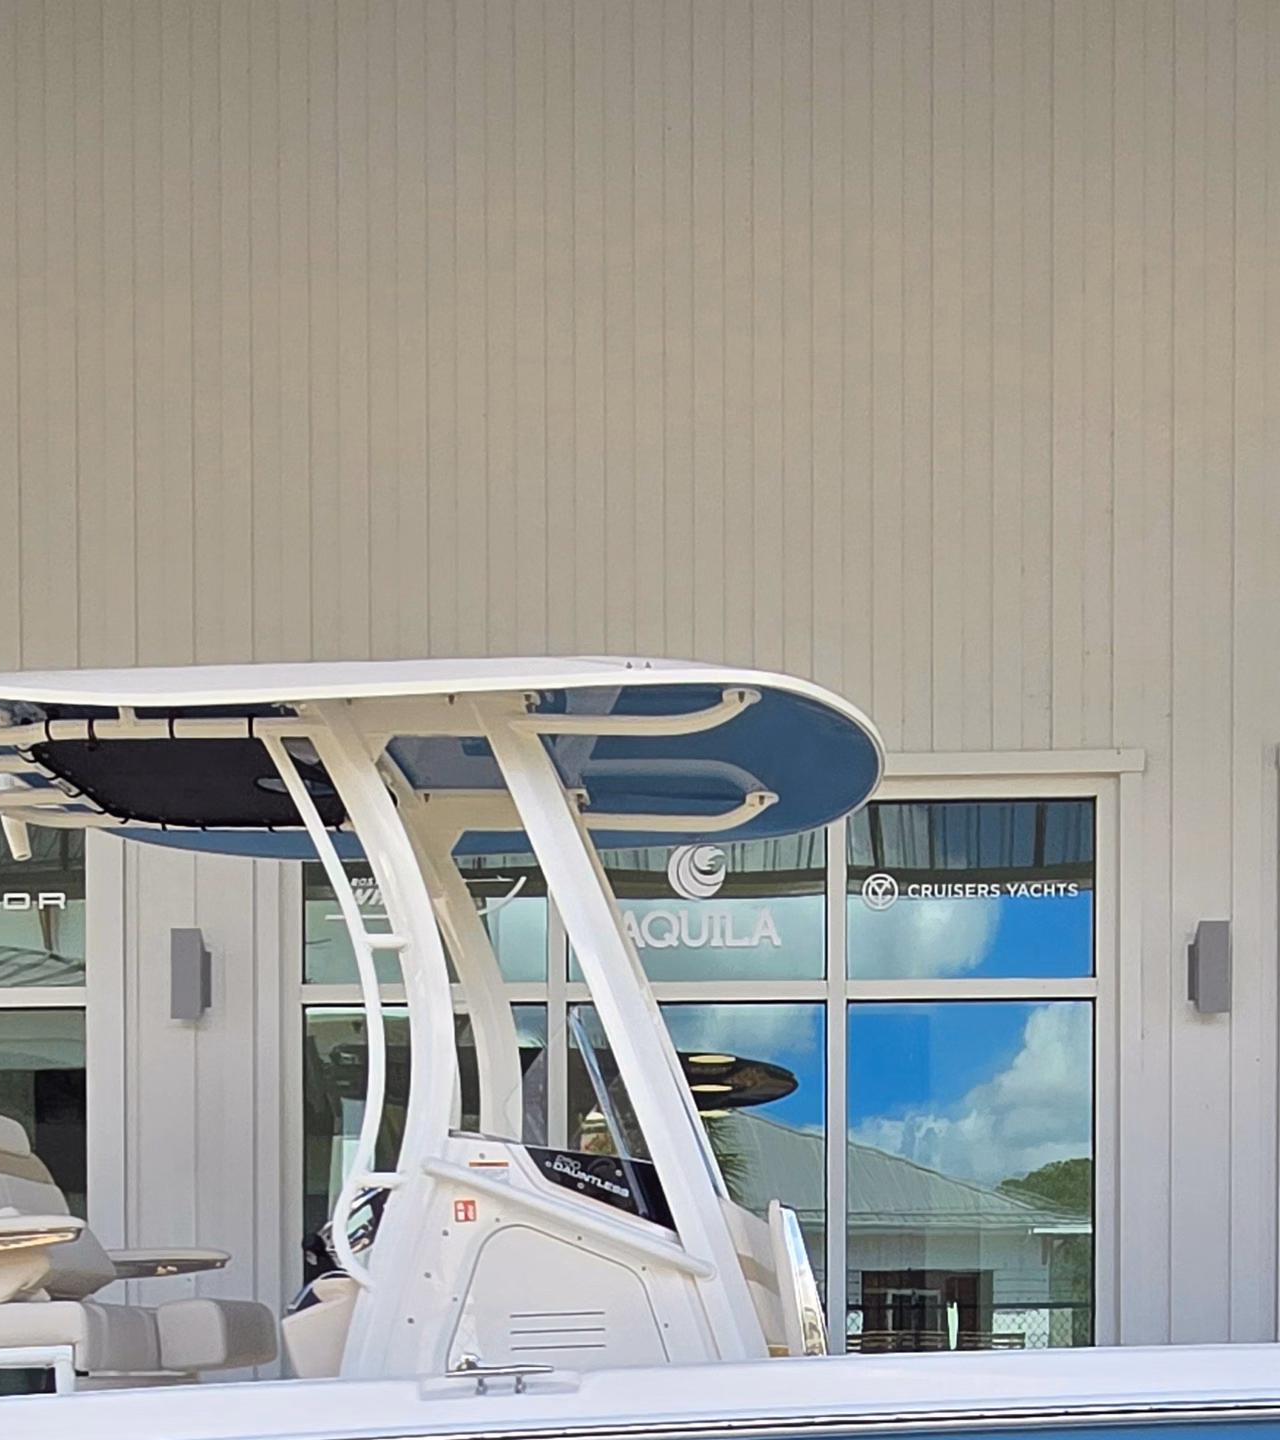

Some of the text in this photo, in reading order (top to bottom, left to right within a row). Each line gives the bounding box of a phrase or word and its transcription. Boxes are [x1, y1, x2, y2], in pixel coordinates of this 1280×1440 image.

[907, 883, 1001, 898] CRUISERS
[1006, 883, 1079, 898] YACHTS
[623, 907, 782, 948] AQUILA
[552, 1161, 629, 1198] DAUNTLESS
